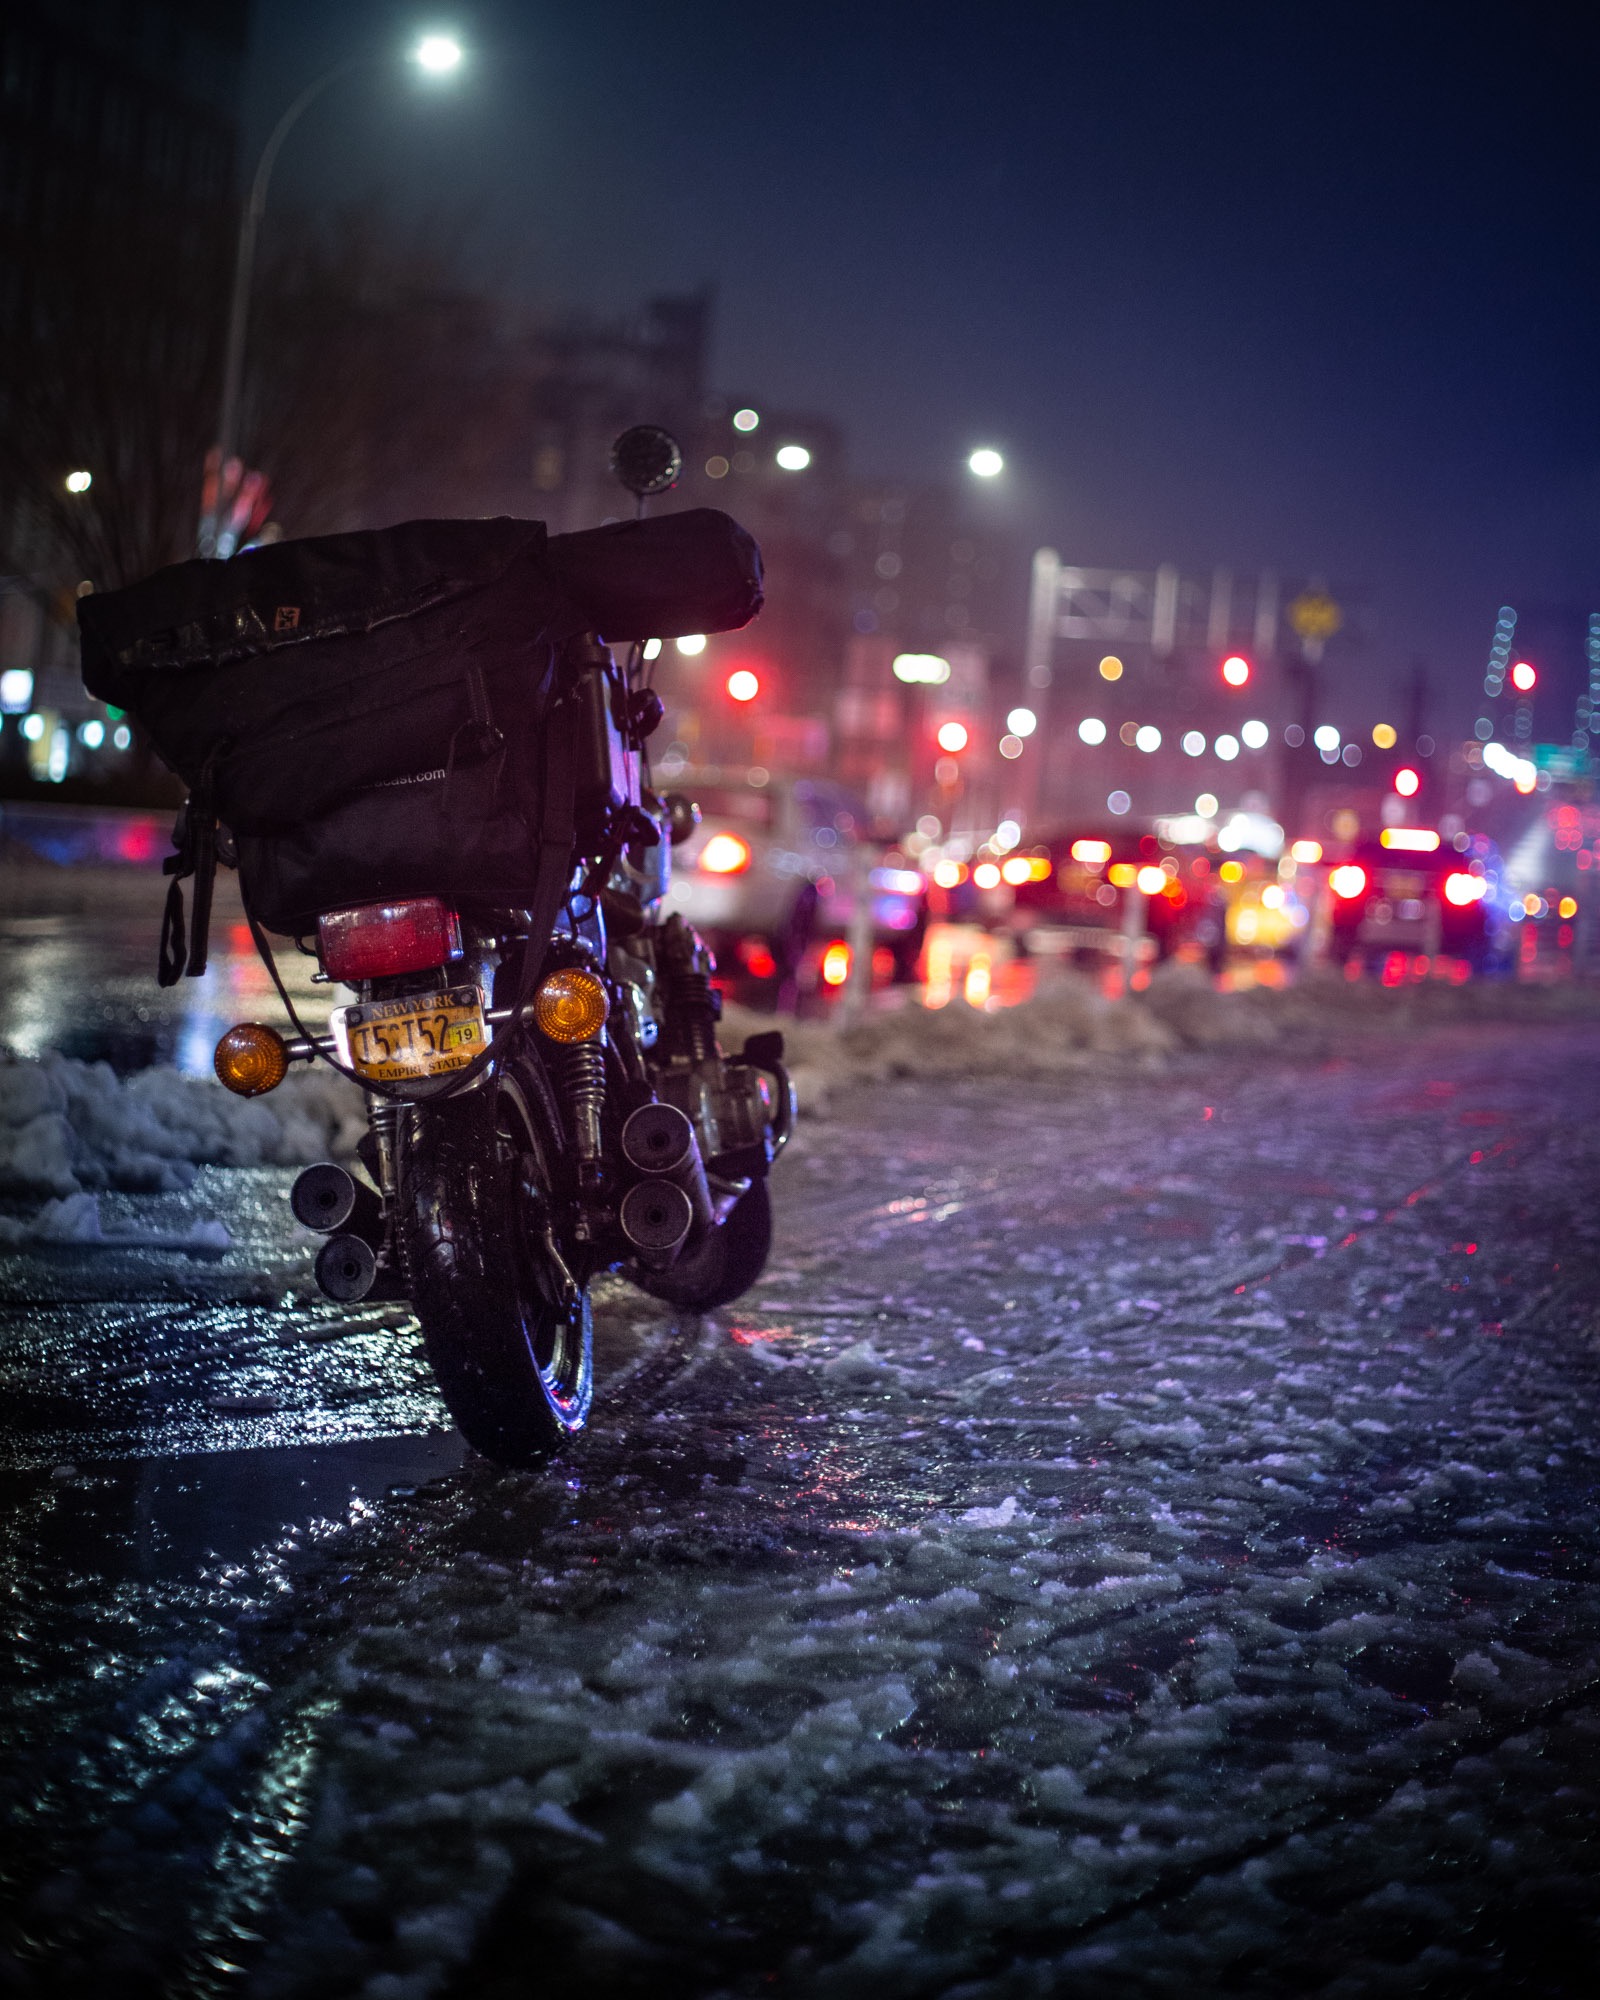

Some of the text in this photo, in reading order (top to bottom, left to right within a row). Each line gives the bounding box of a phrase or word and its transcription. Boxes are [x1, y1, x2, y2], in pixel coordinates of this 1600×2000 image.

[372, 994, 455, 1018] NEW YORK
[455, 1028, 473, 1042] 19
[429, 1057, 465, 1071] STATE
